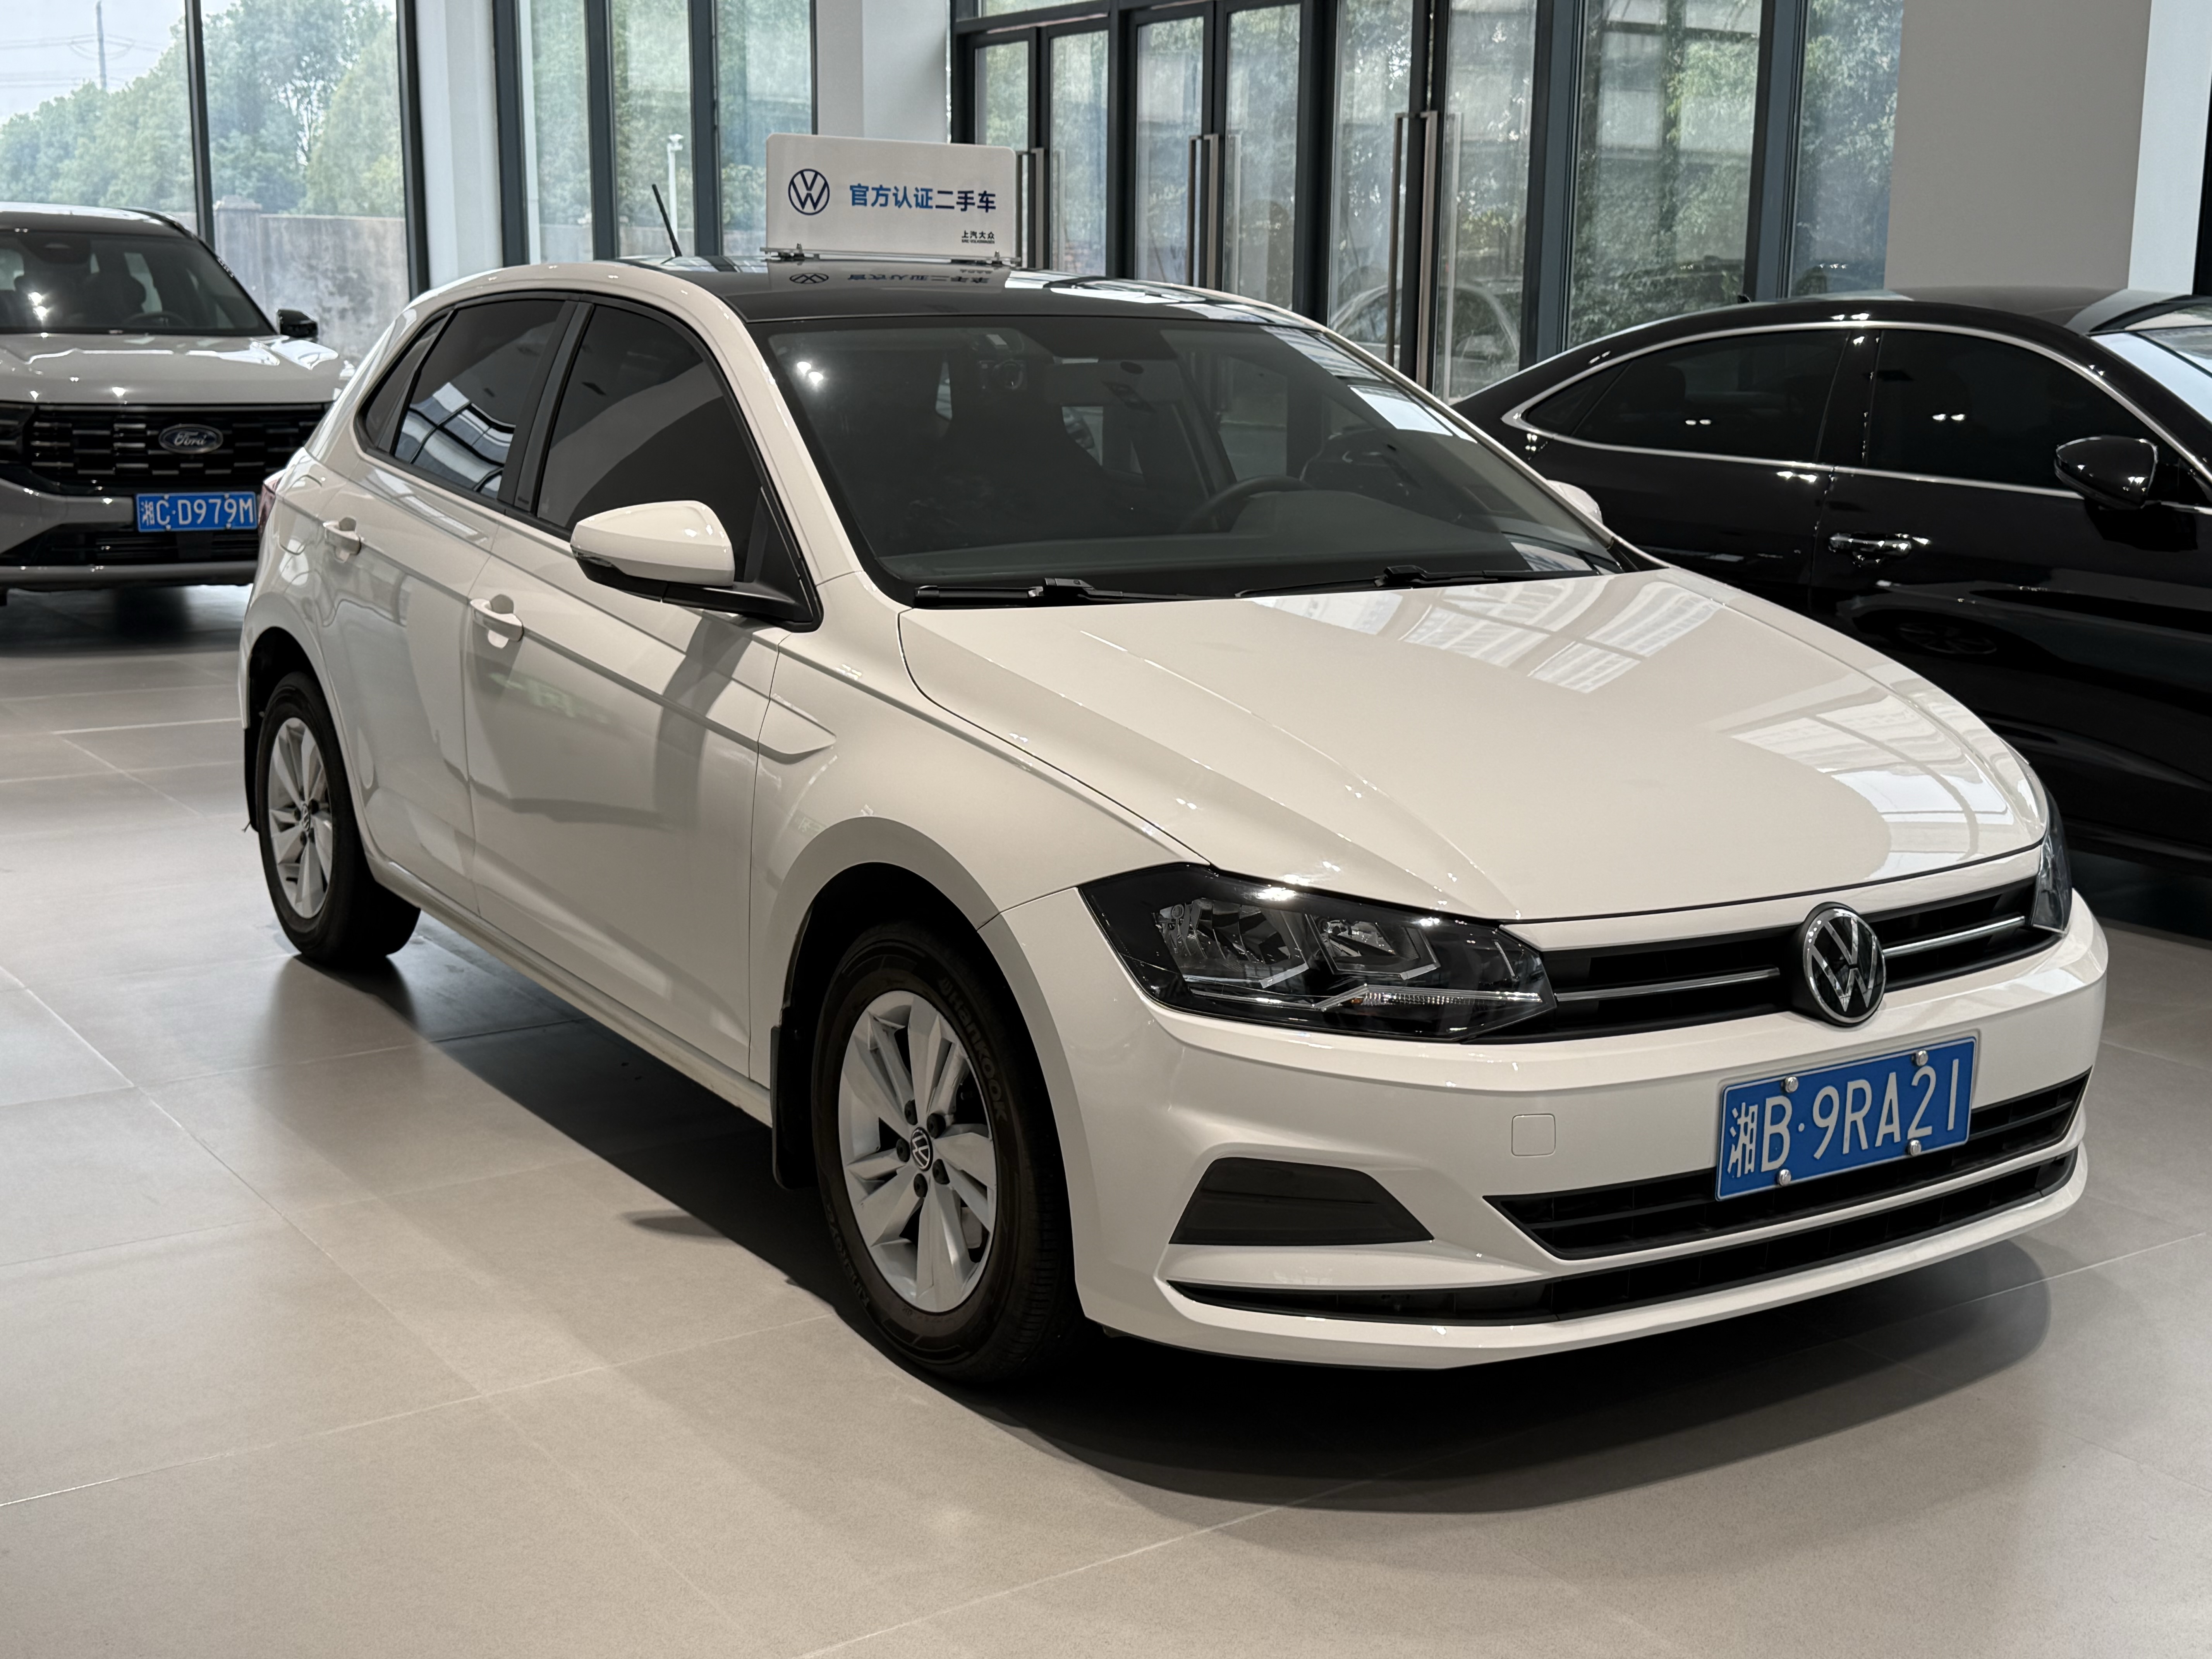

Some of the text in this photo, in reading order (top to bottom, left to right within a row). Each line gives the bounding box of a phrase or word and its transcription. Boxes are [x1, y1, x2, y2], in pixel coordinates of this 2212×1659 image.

[849, 183, 996, 213] 官方认证二手车
[962, 230, 994, 239] 上汽大众
[173, 431, 207, 446] Ford
